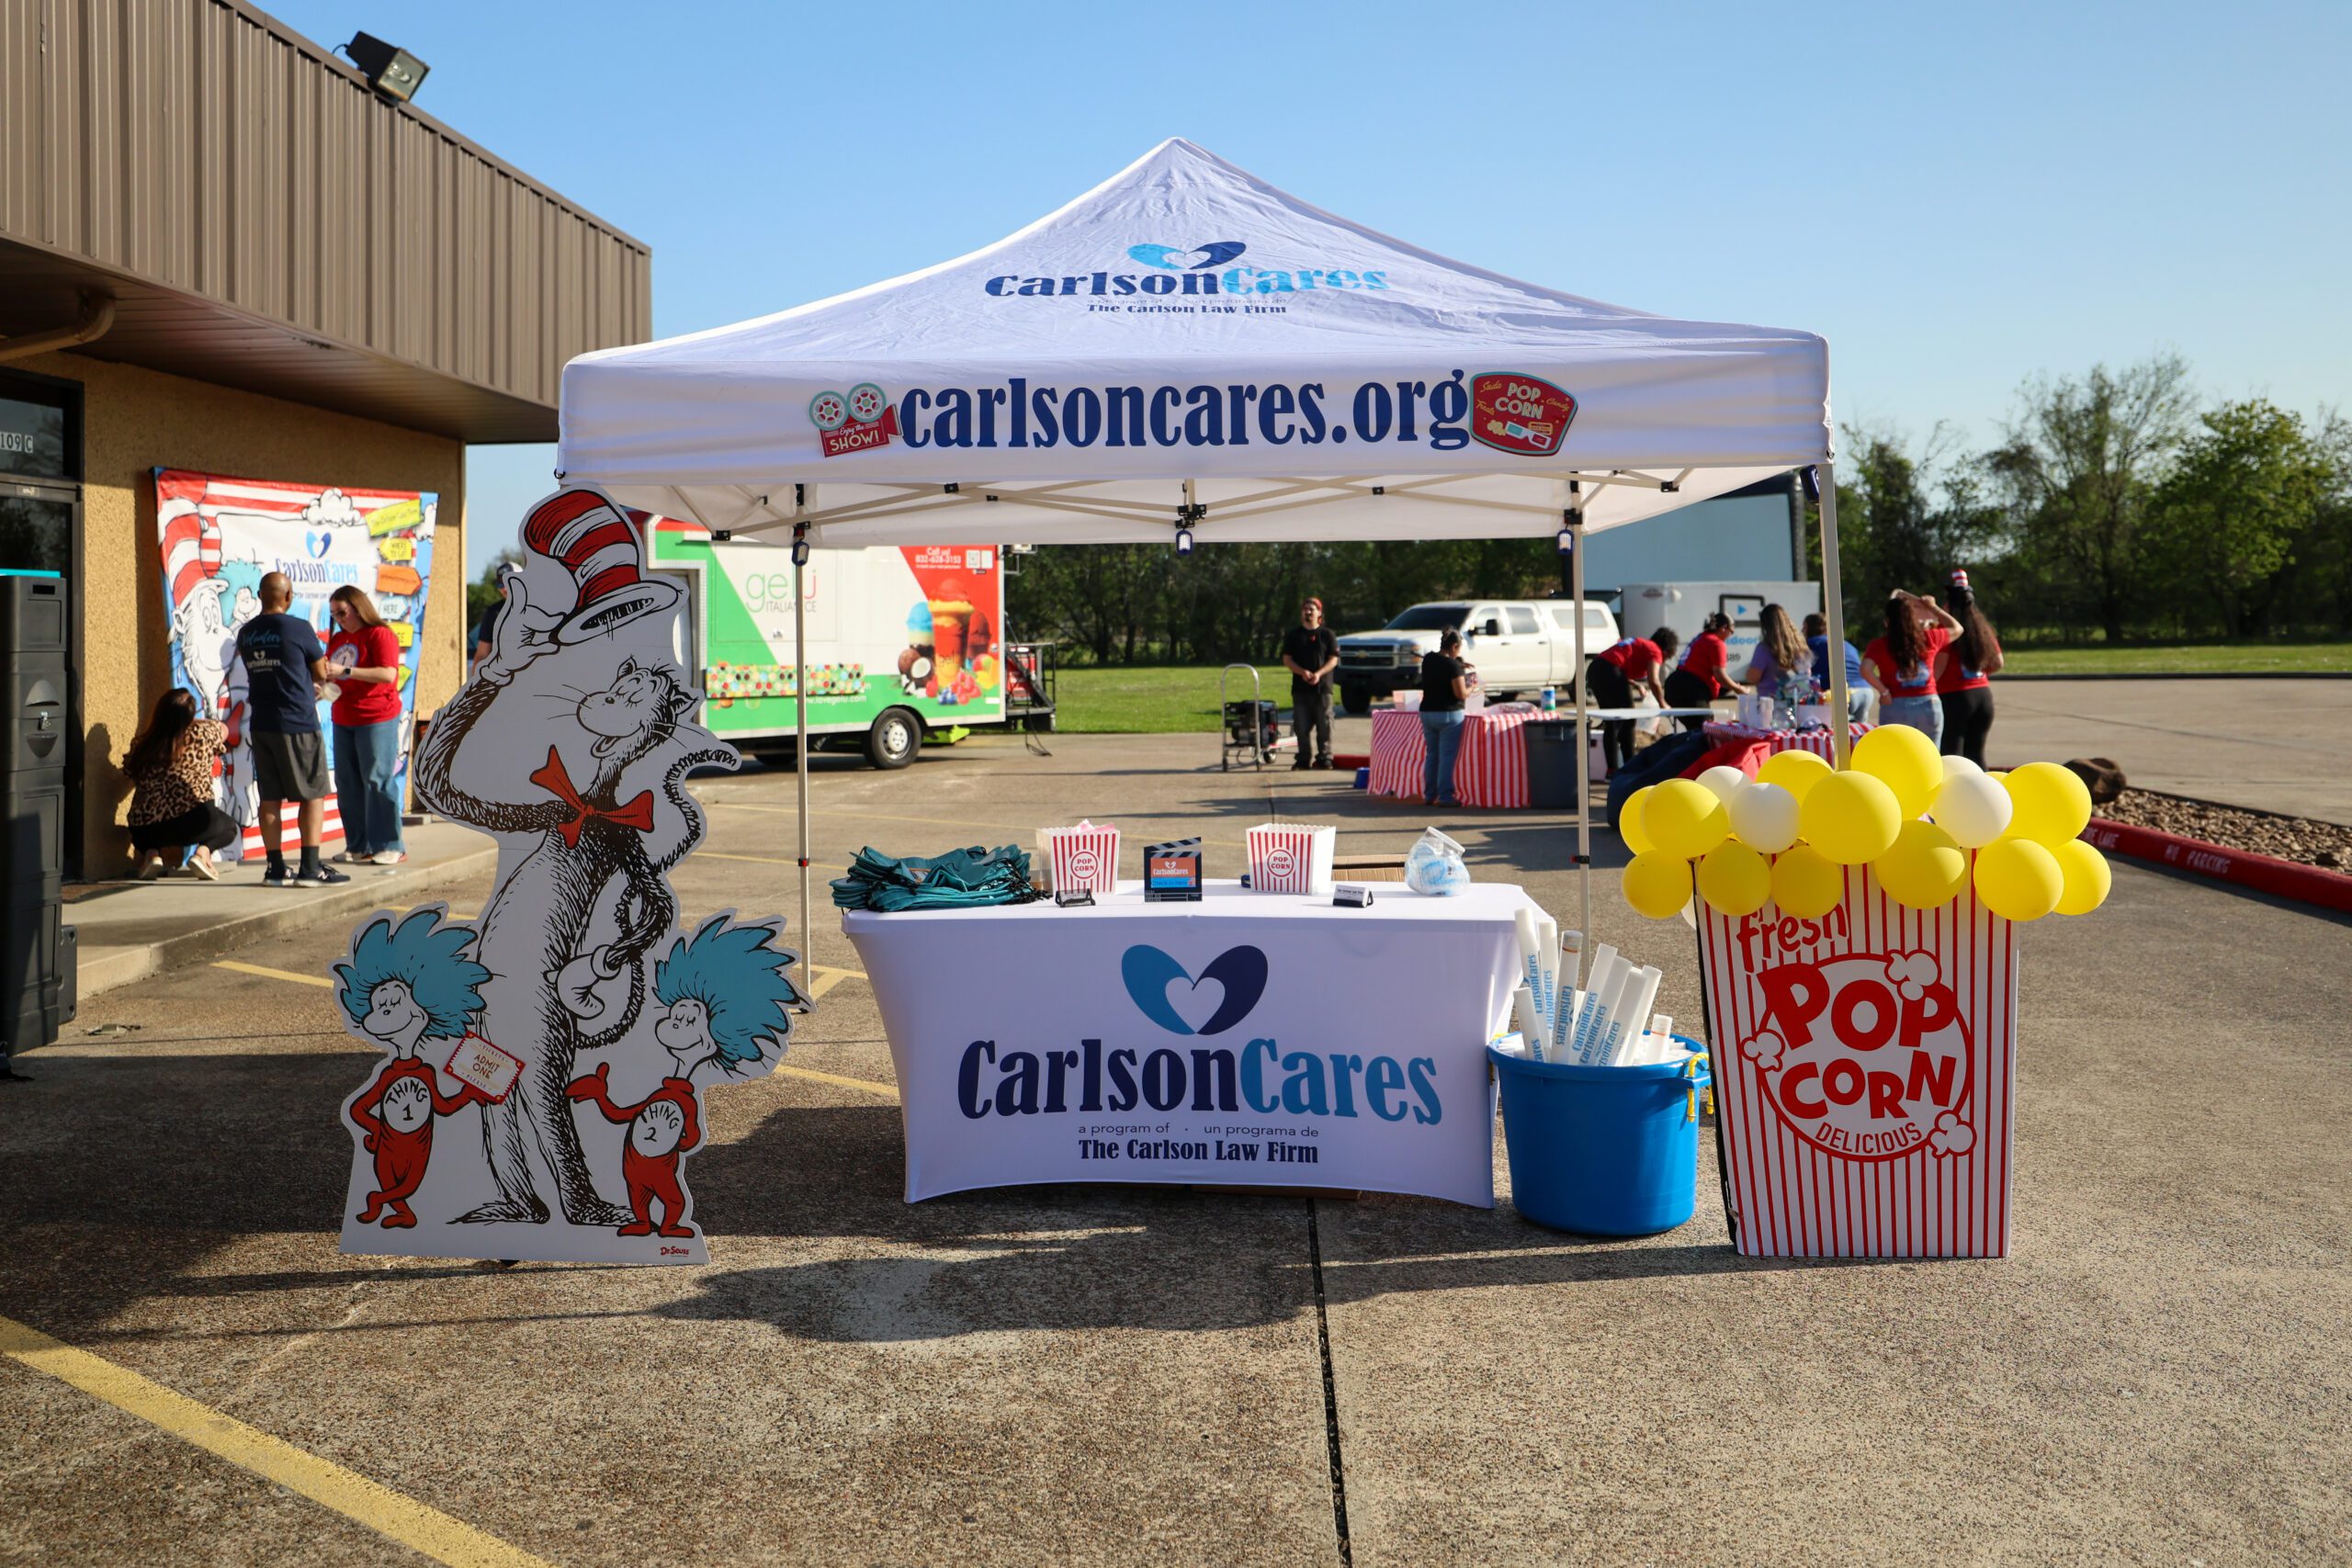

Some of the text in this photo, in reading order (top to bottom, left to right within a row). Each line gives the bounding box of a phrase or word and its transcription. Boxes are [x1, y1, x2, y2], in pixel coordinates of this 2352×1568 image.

[1127, 305, 1194, 313] Carlson
[1202, 305, 1237, 313] Law
[1245, 305, 1286, 313] Firm
[1507, 382, 1542, 401] POP
[900, 369, 1470, 450] carlsoncares.org
[1495, 397, 1544, 420] CORN
[839, 423, 865, 436] Enjoy the
[830, 430, 879, 452] SHOW!
[383, 604, 398, 615] HERE
[805, 601, 817, 613] CE
[2164, 844, 2232, 874] NO PARKING
[1757, 964, 1958, 1051] POP
[472, 1063, 493, 1079] ONE
[474, 1054, 500, 1073] ADMIT
[385, 1079, 428, 1104] THING
[958, 1039, 1442, 1125] CarlsonCares
[1780, 1050, 1957, 1120] CORN
[402, 1103, 413, 1122] 1
[644, 1127, 657, 1142] 2
[1091, 1125, 1150, 1136] program
[1156, 1122, 1170, 1134] of
[1226, 1126, 1296, 1137] programa
[1300, 1126, 1319, 1137] de
[1815, 1122, 1922, 1155] DELICIOUS
[1079, 1139, 1318, 1163] The Carlson Law Firm
